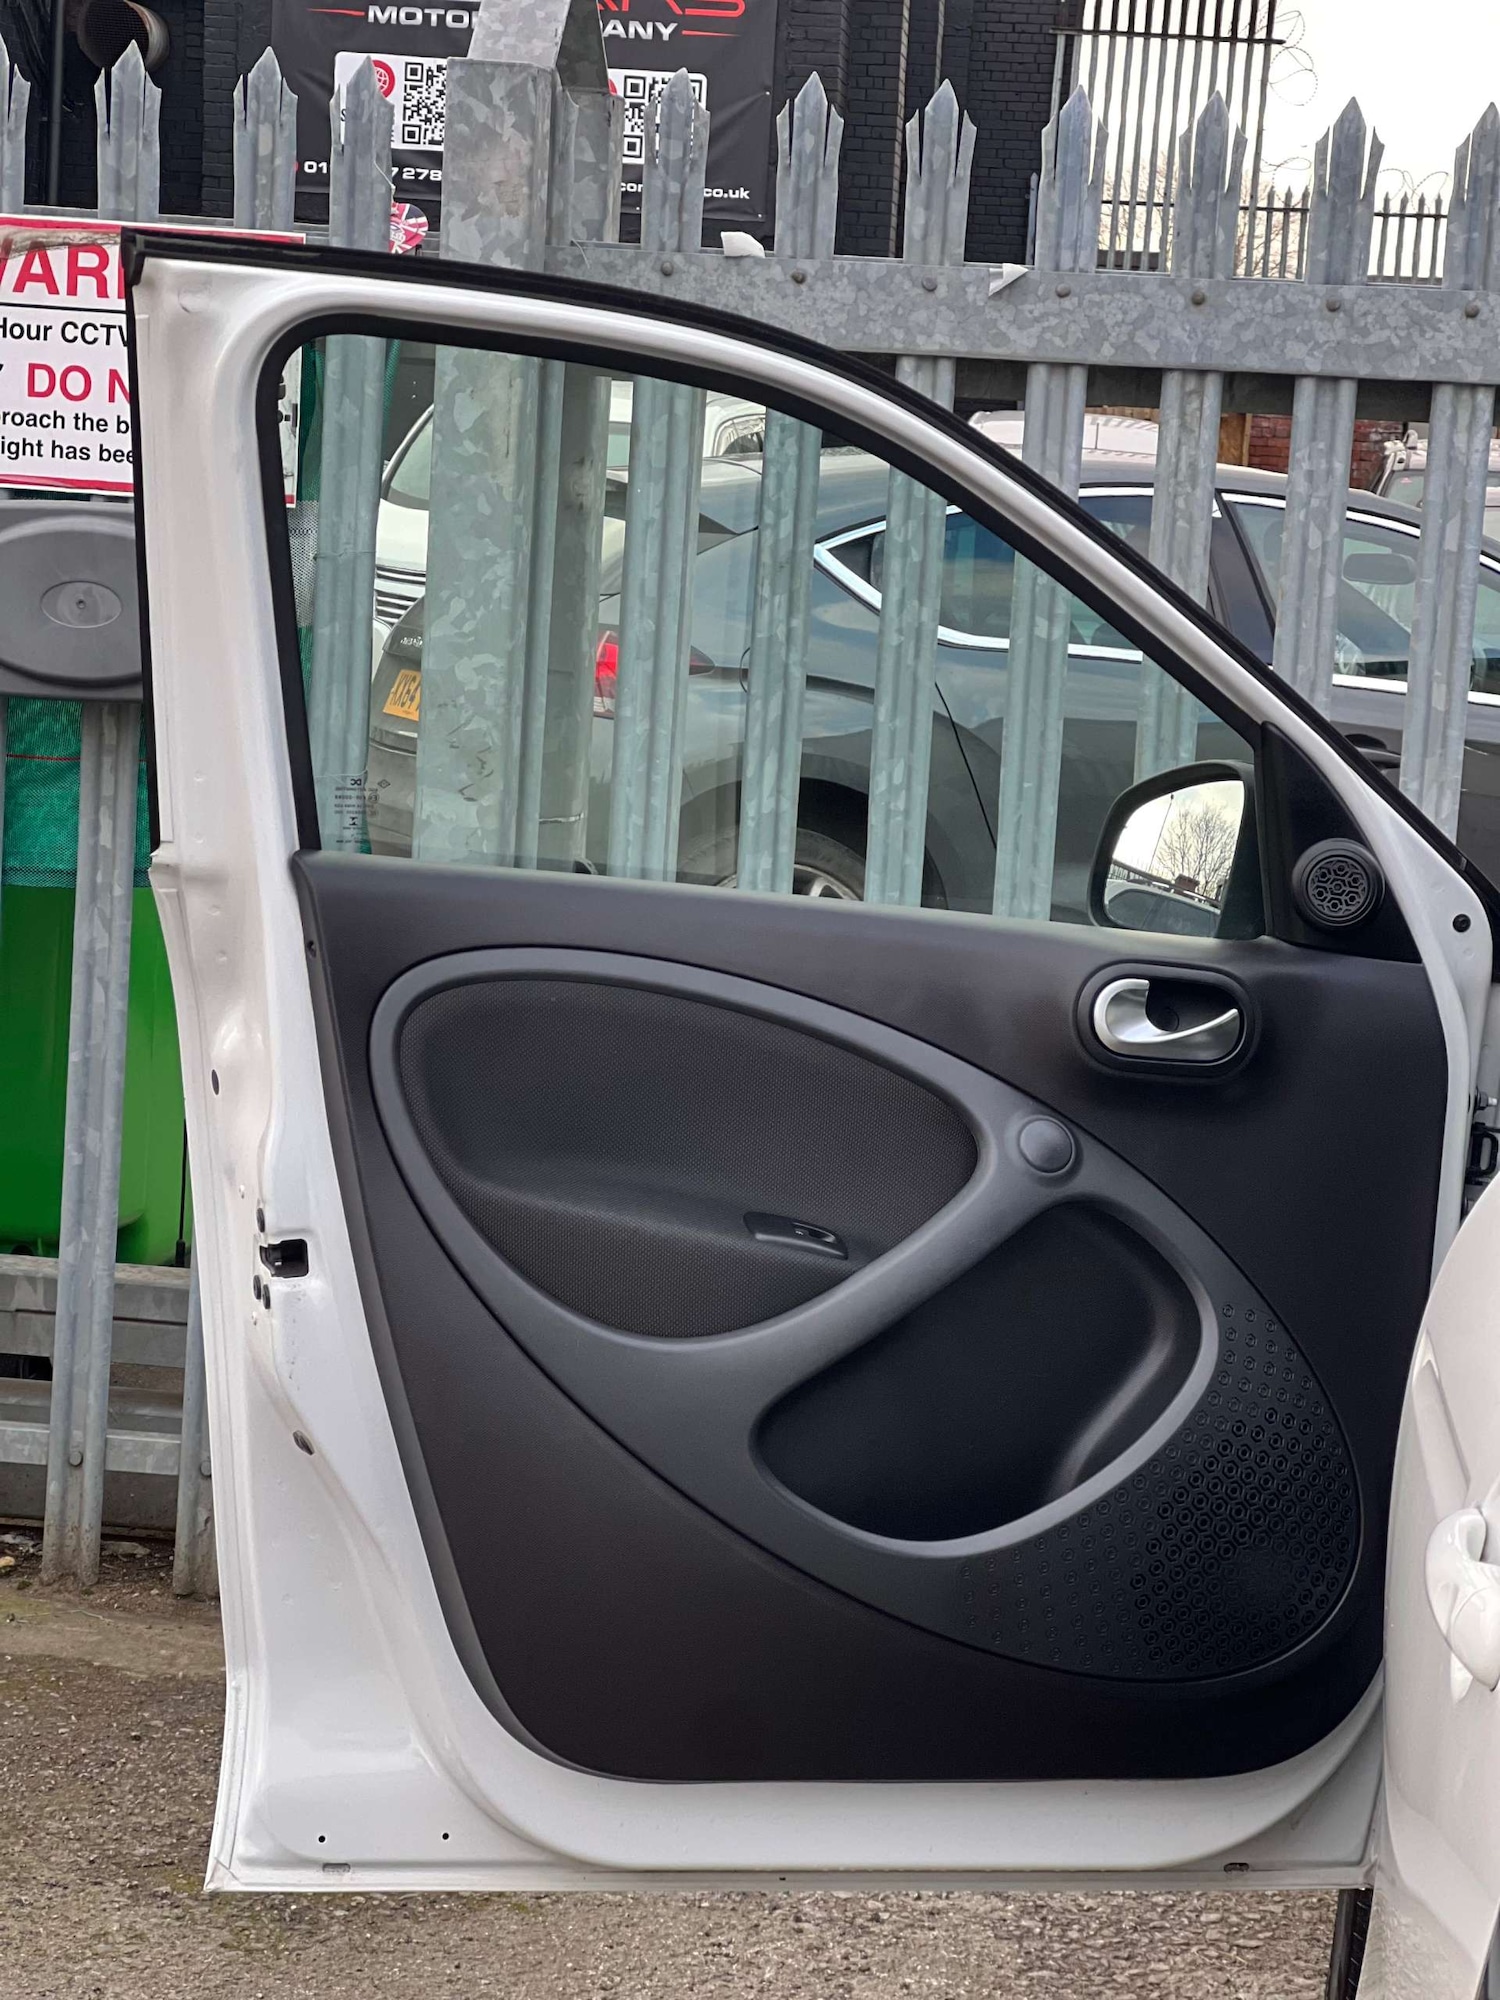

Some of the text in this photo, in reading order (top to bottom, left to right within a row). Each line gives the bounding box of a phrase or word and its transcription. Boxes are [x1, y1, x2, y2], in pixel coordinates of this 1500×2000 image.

[368, 5, 678, 41] MOTO ANY
[304, 161, 328, 174] 01
[0, 239, 125, 299] AR
[27, 362, 130, 404] DO N
[0, 410, 129, 434] roach the b
[1, 436, 133, 464] ight has bee
